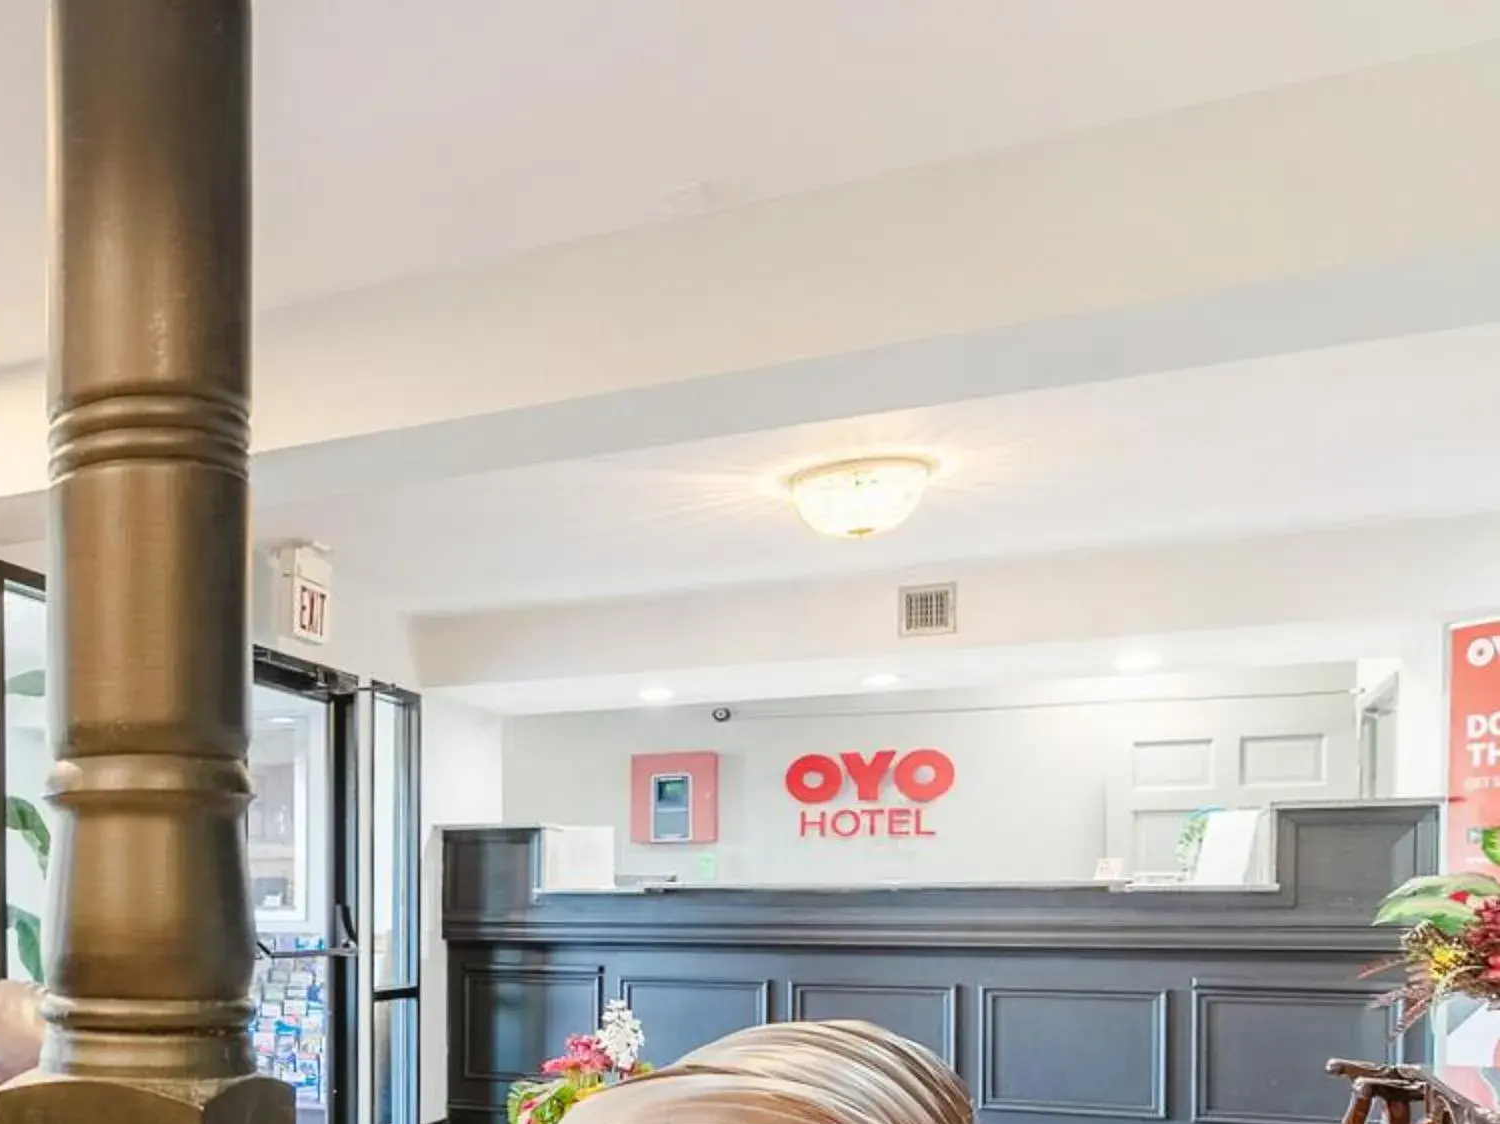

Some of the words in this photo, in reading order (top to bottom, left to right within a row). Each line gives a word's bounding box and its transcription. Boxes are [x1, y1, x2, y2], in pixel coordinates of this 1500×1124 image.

[300, 585, 326, 636] EXIT
[785, 749, 955, 804] OYO
[800, 807, 936, 837] HOTEL
